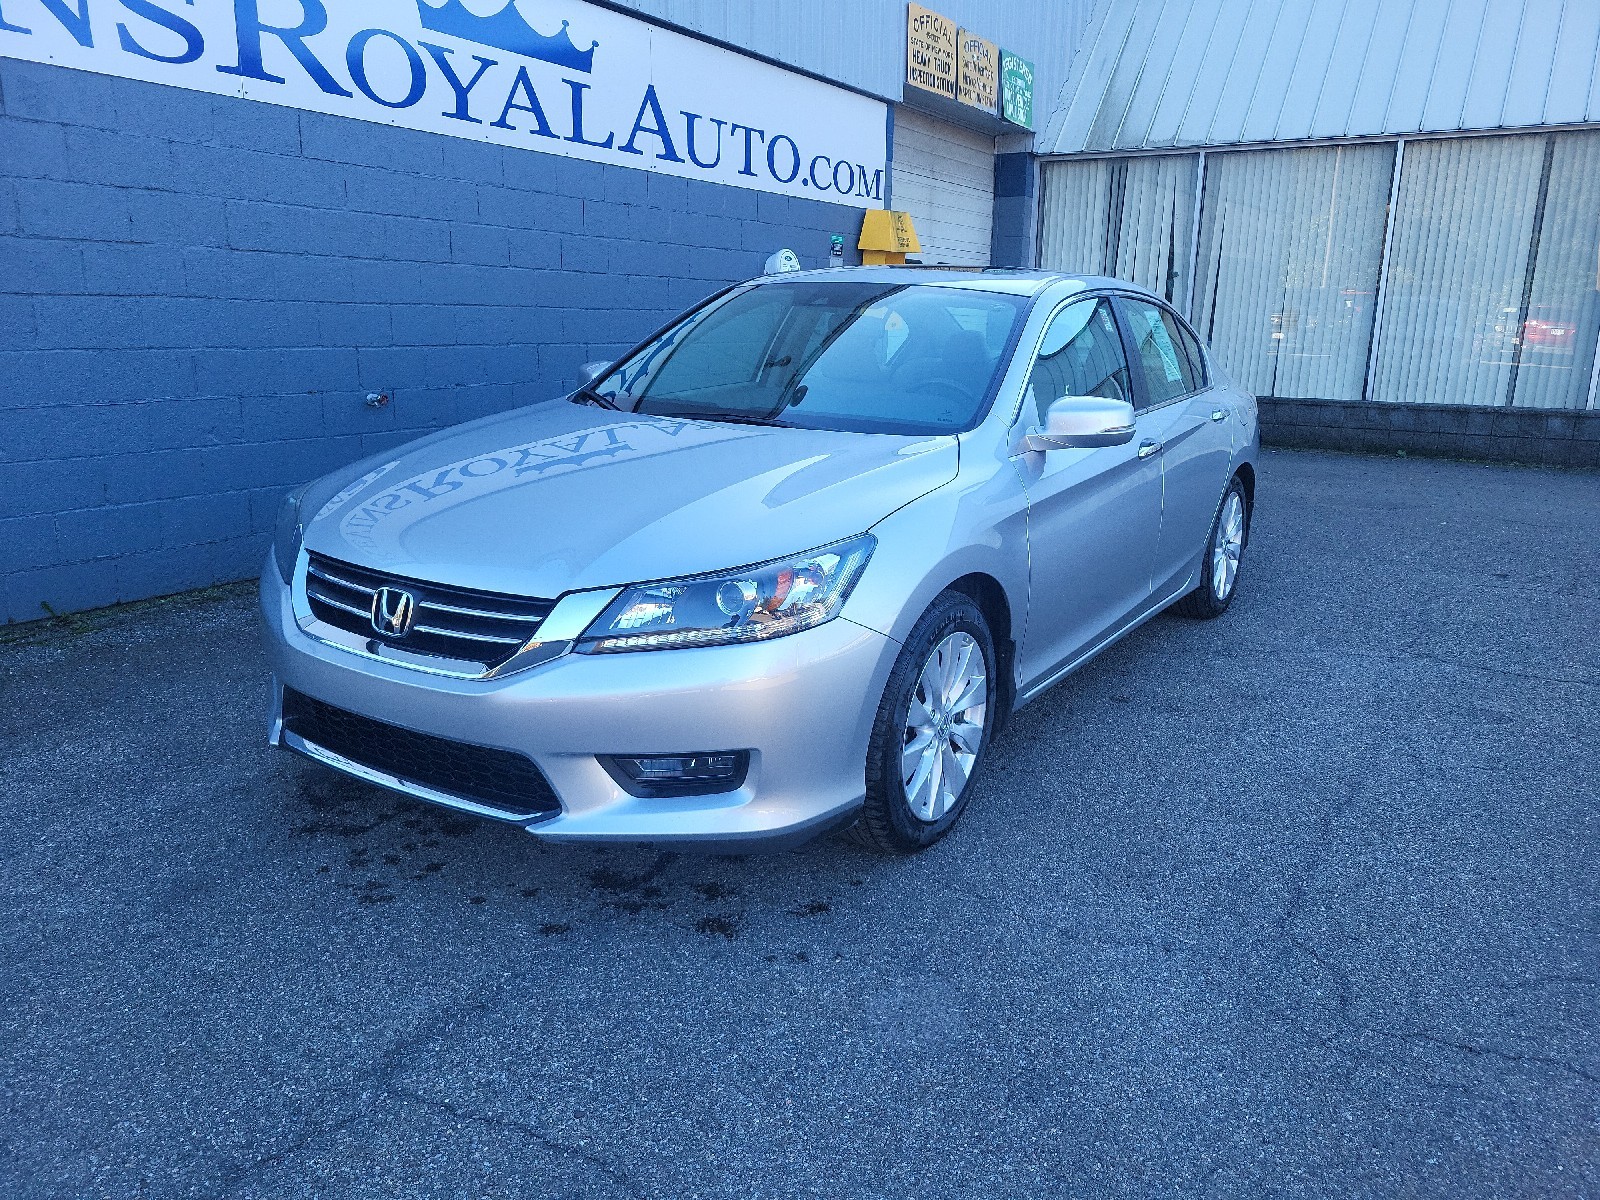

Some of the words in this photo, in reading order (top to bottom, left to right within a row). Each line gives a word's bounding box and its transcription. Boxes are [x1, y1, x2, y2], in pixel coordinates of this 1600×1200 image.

[913, 14, 953, 47] OFFICIAL
[912, 48, 931, 69] HEAVY
[963, 39, 993, 68] OFFICIAL
